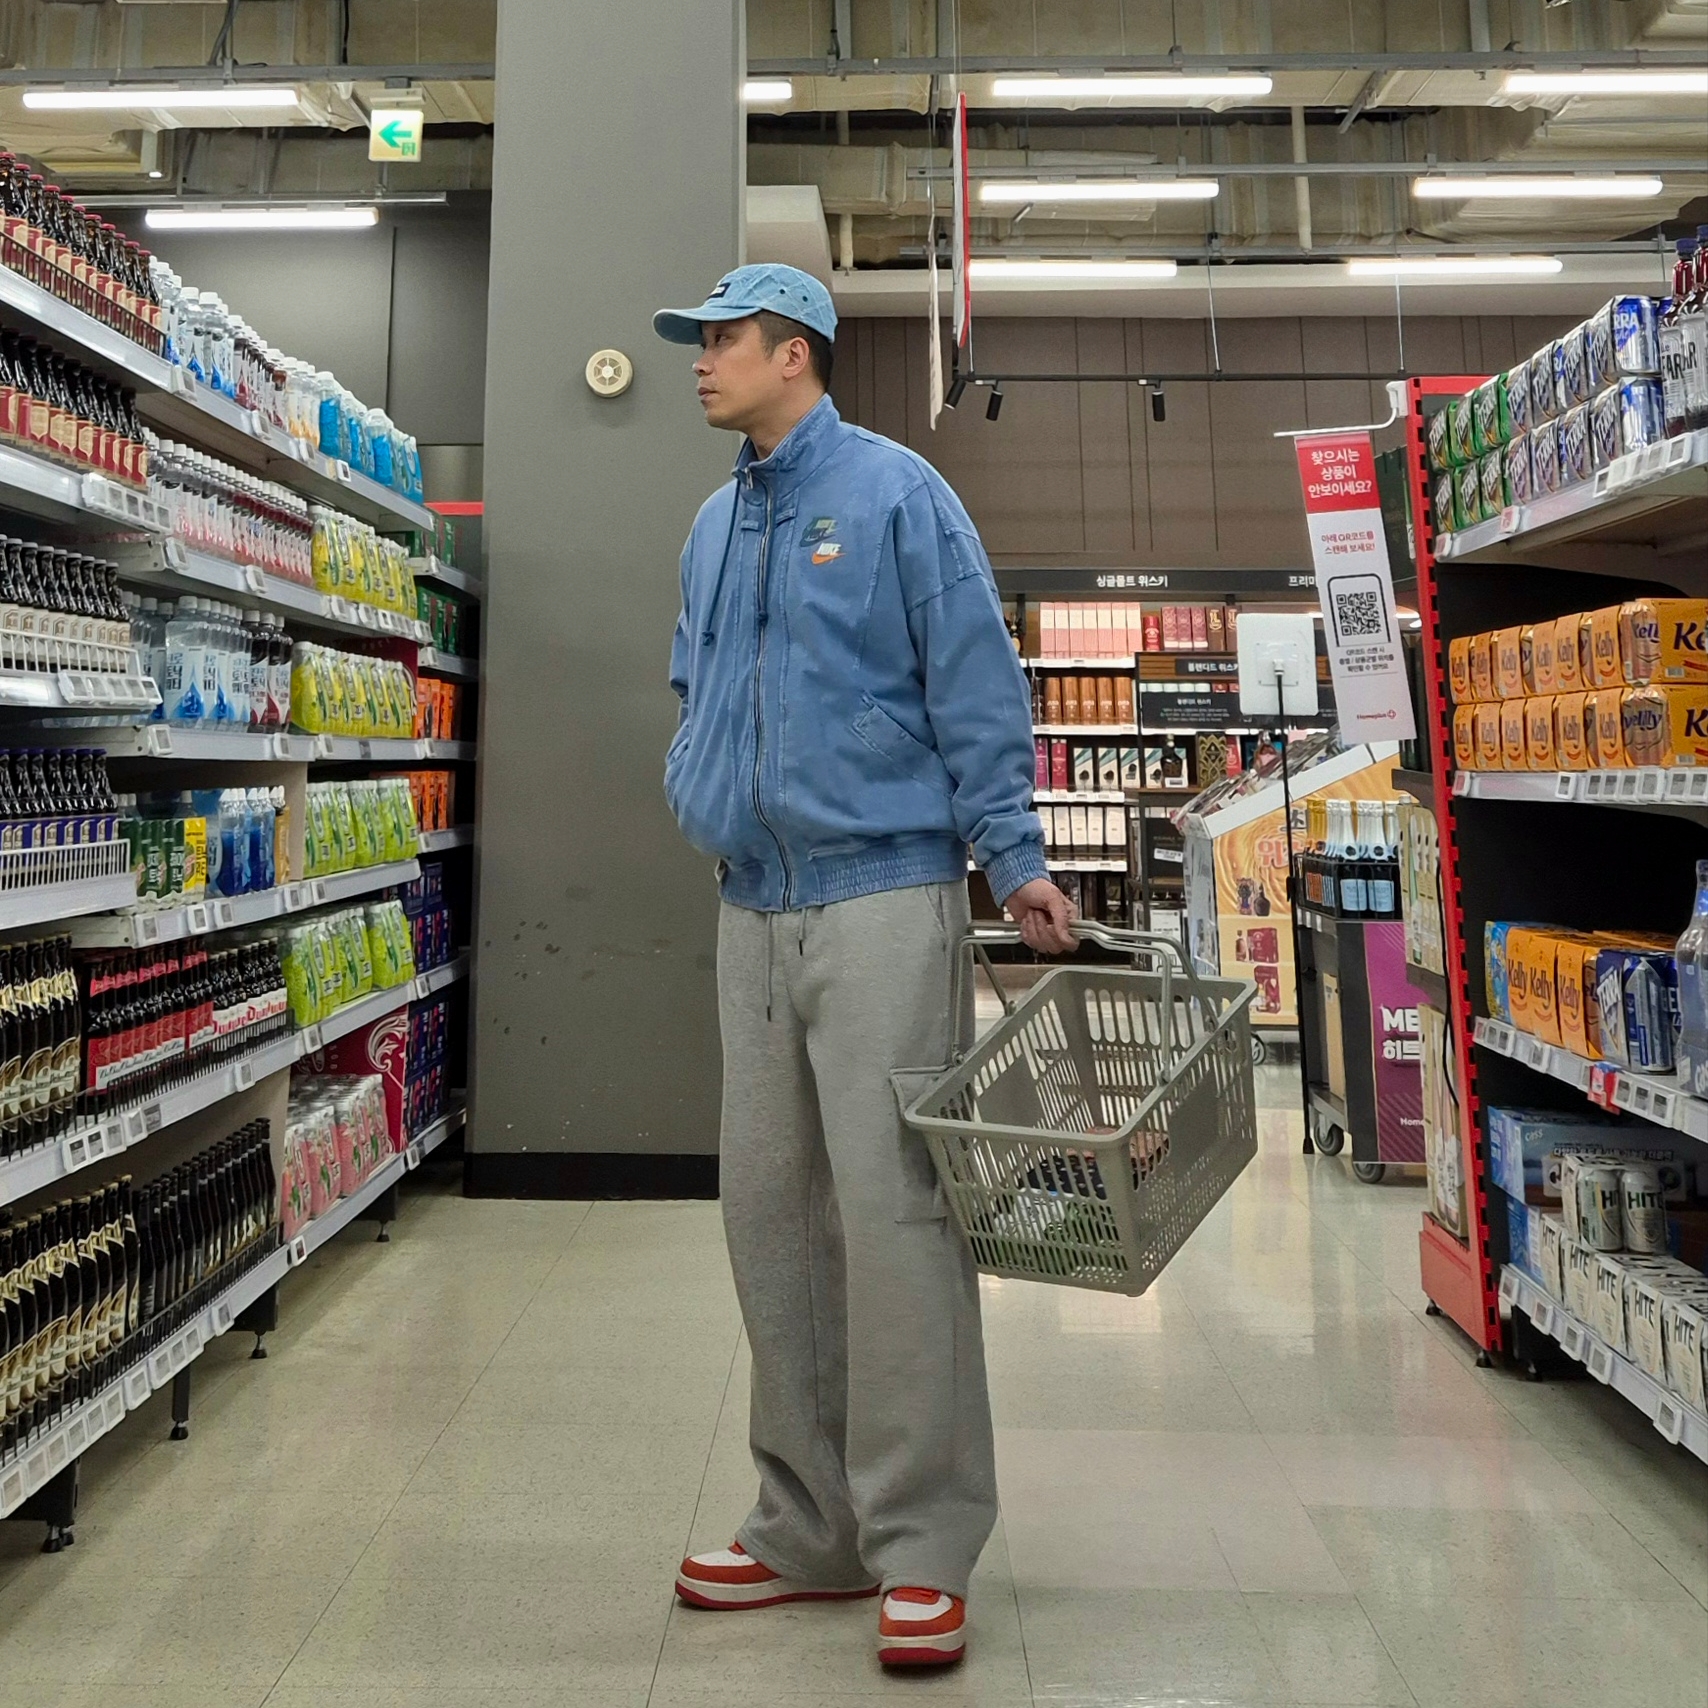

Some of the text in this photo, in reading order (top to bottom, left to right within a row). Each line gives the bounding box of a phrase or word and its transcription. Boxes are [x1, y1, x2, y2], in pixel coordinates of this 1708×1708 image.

[1311, 448, 1360, 465] 찾으시는
[1321, 464, 1356, 480] 상품이
[1308, 480, 1372, 498] 안보이세요?
[1321, 530, 1374, 543] 아래 QR코드를
[1349, 542, 1375, 553] 보세요!
[1096, 575, 1168, 588] 싱글몰트 위스키
[1530, 967, 1552, 1011] Kelly
